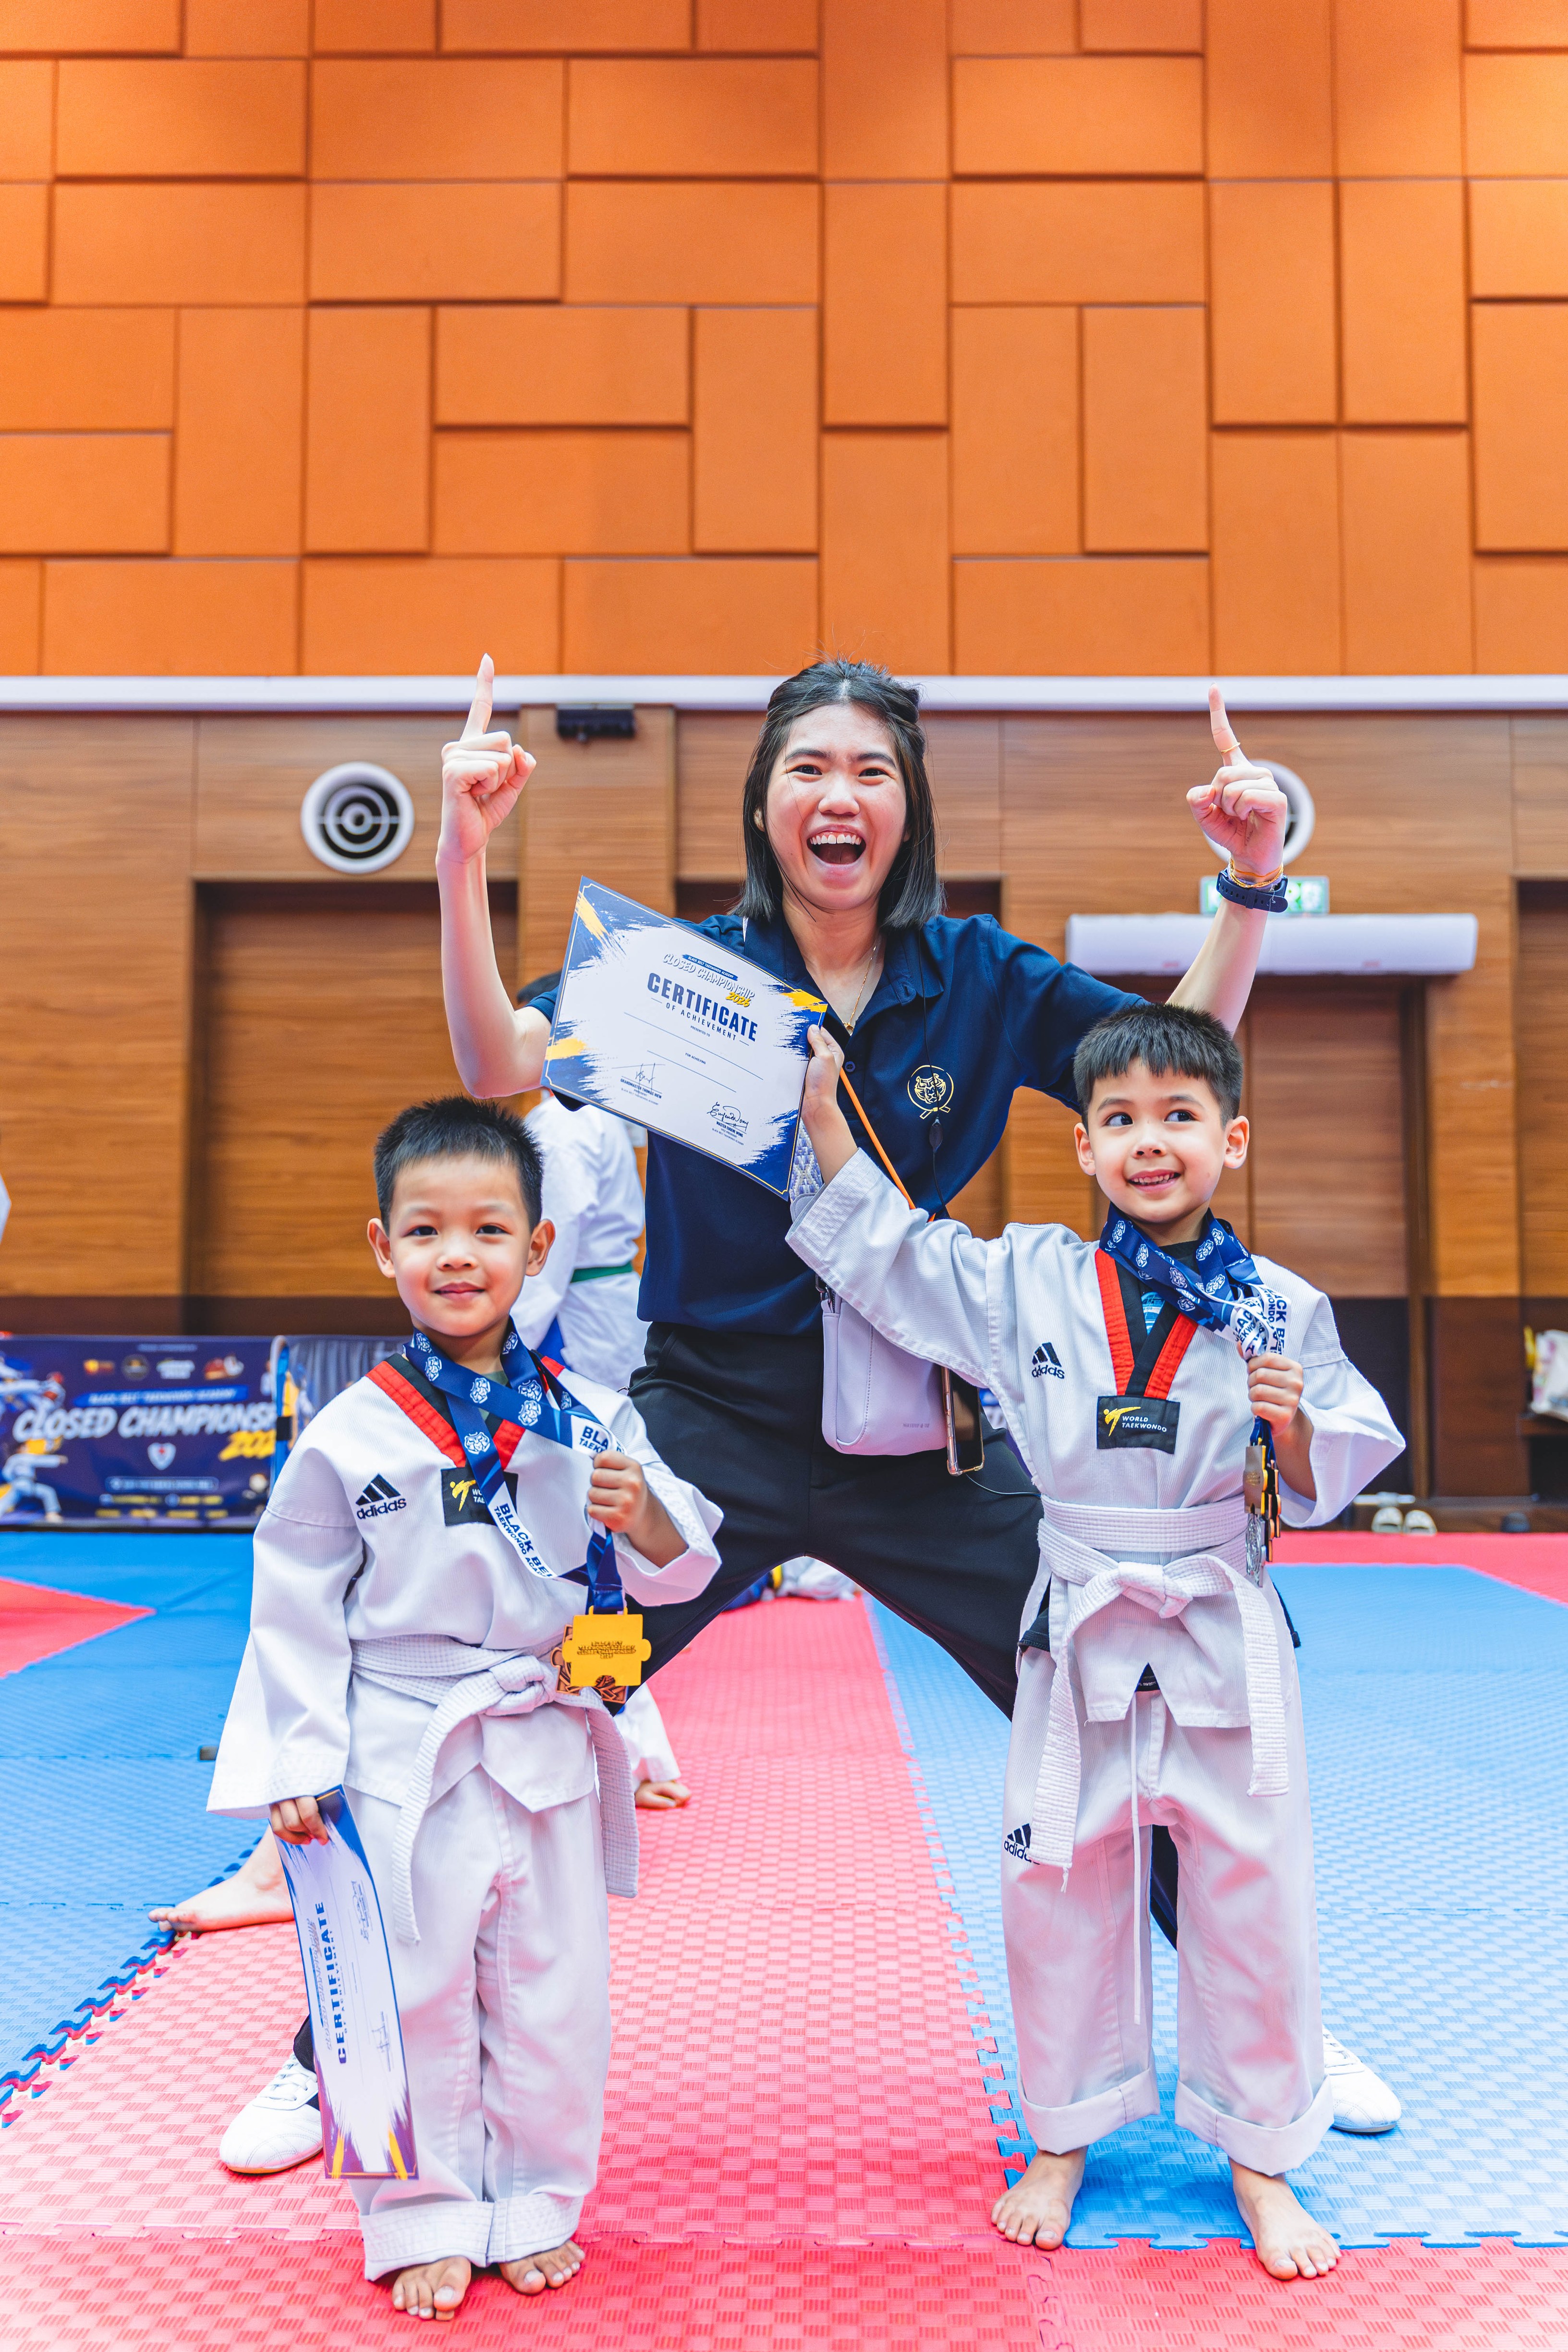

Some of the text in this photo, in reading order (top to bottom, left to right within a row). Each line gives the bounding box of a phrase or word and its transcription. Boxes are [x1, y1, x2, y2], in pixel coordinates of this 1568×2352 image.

[663, 953, 755, 999] CLOSED CHAMPIONSHIP
[647, 972, 758, 1042] CERTIFICATE
[725, 991, 751, 1007] 2026
[666, 1002, 736, 1041] OF ACHIEVEMENT
[691, 1025, 706, 1035] PRESENTED
[12, 1407, 119, 1442] CLOSED
[1121, 1422, 1167, 1432] TAEKWONDO
[356, 1497, 407, 1520] adidas
[499, 1503, 535, 1552] BLACK
[494, 1506, 527, 1554] TAEKWONDO
[315, 1902, 347, 2064] CERTIFICATE
